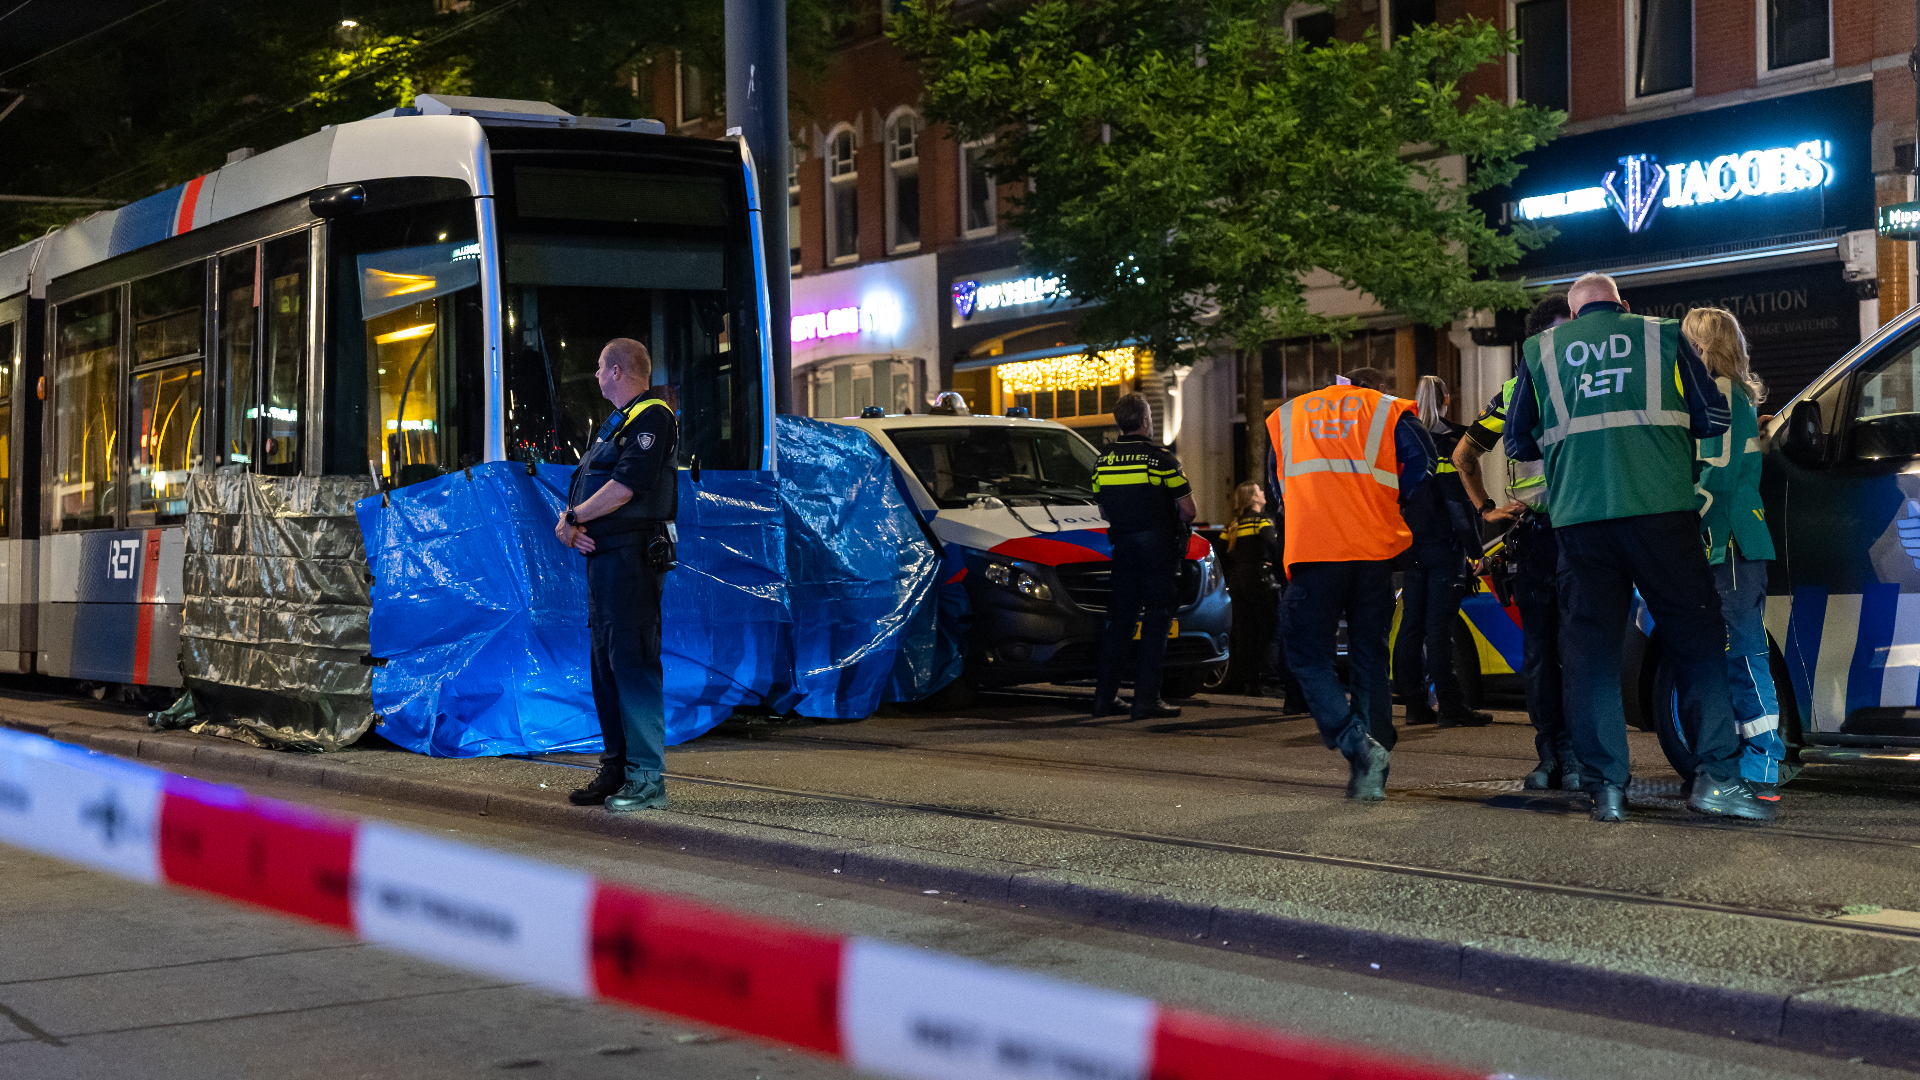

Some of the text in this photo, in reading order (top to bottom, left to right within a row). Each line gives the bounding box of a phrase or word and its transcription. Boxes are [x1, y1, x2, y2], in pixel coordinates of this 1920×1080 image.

[1565, 334, 1632, 367] OvD
[1574, 367, 1632, 401] RET
[1303, 396, 1363, 413] OvD
[1303, 418, 1358, 441] RET
[1103, 451, 1141, 466] POLITIE
[107, 539, 140, 579] RET
